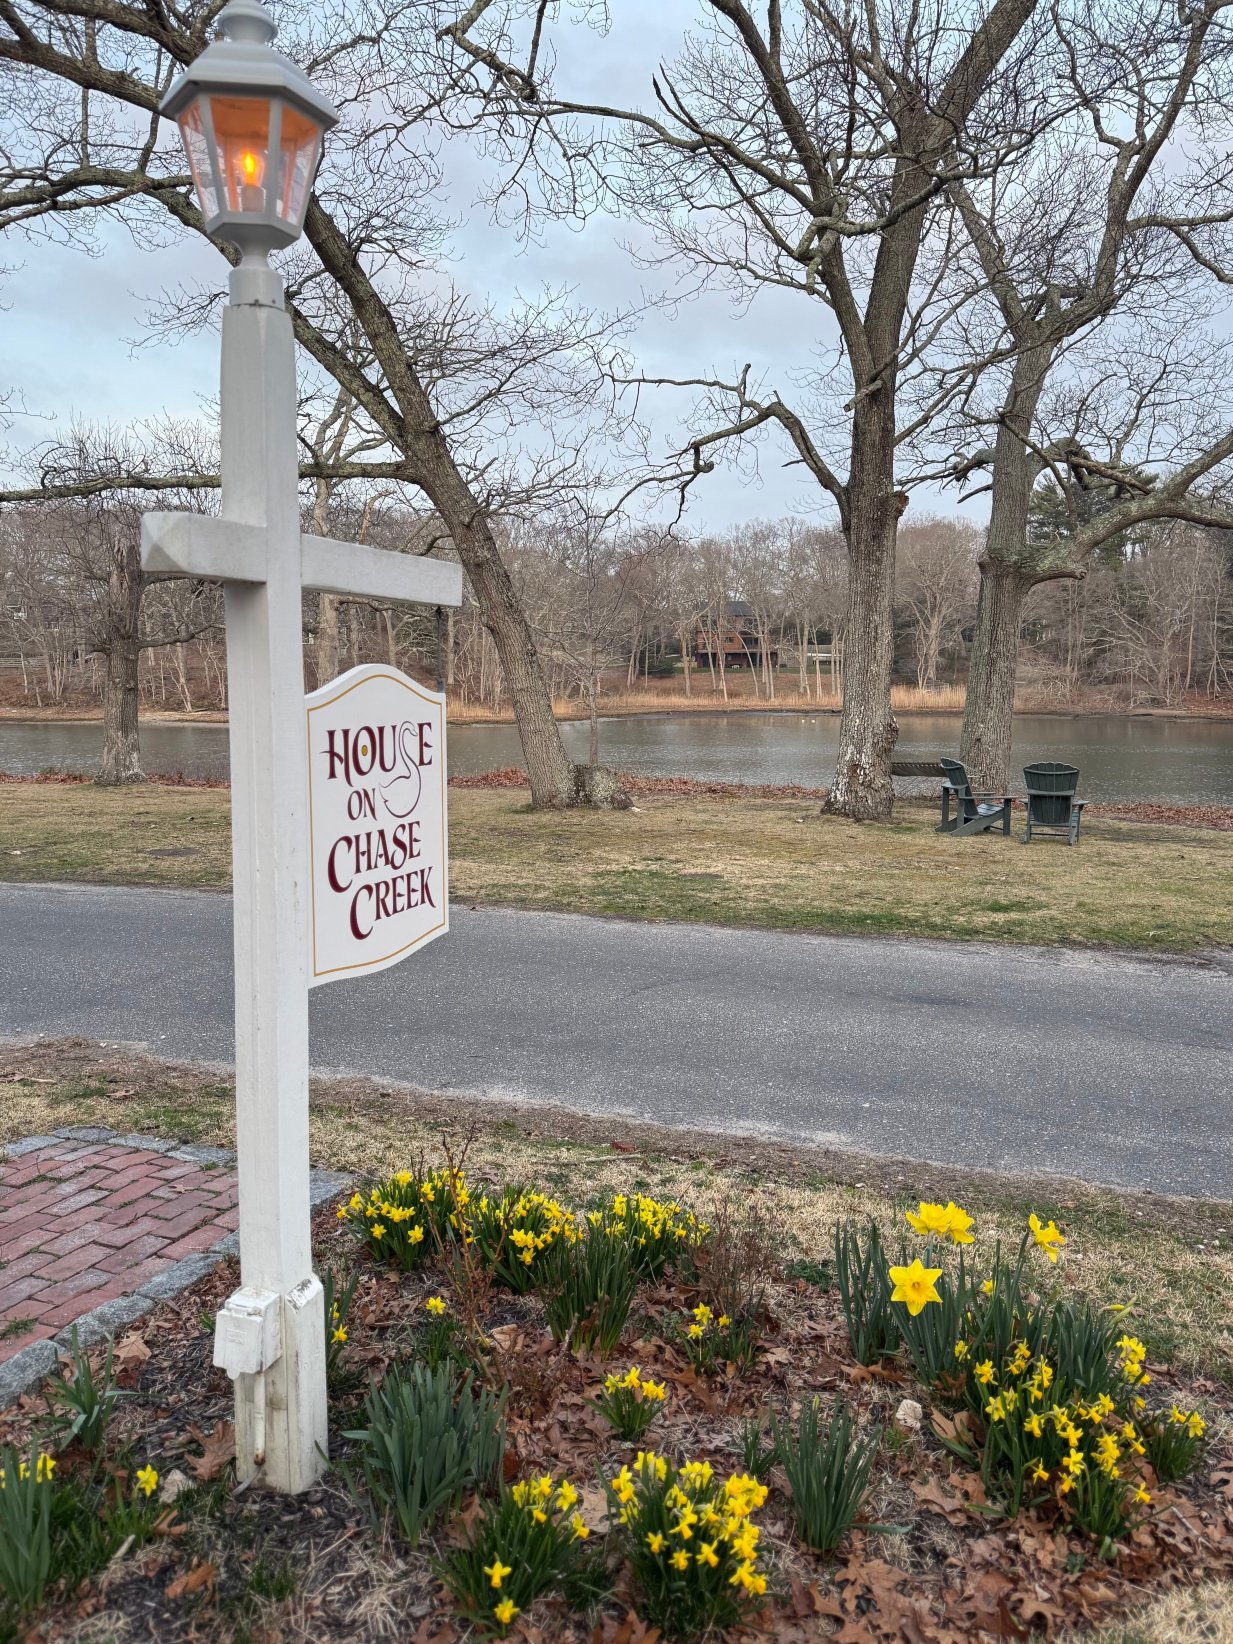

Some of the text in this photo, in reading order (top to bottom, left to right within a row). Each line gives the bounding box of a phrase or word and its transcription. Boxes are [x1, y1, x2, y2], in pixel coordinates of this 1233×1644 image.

[319, 720, 434, 788] HOUSE
[347, 788, 377, 821] ON
[327, 821, 422, 893] CHASE
[349, 866, 437, 940] CREEK
